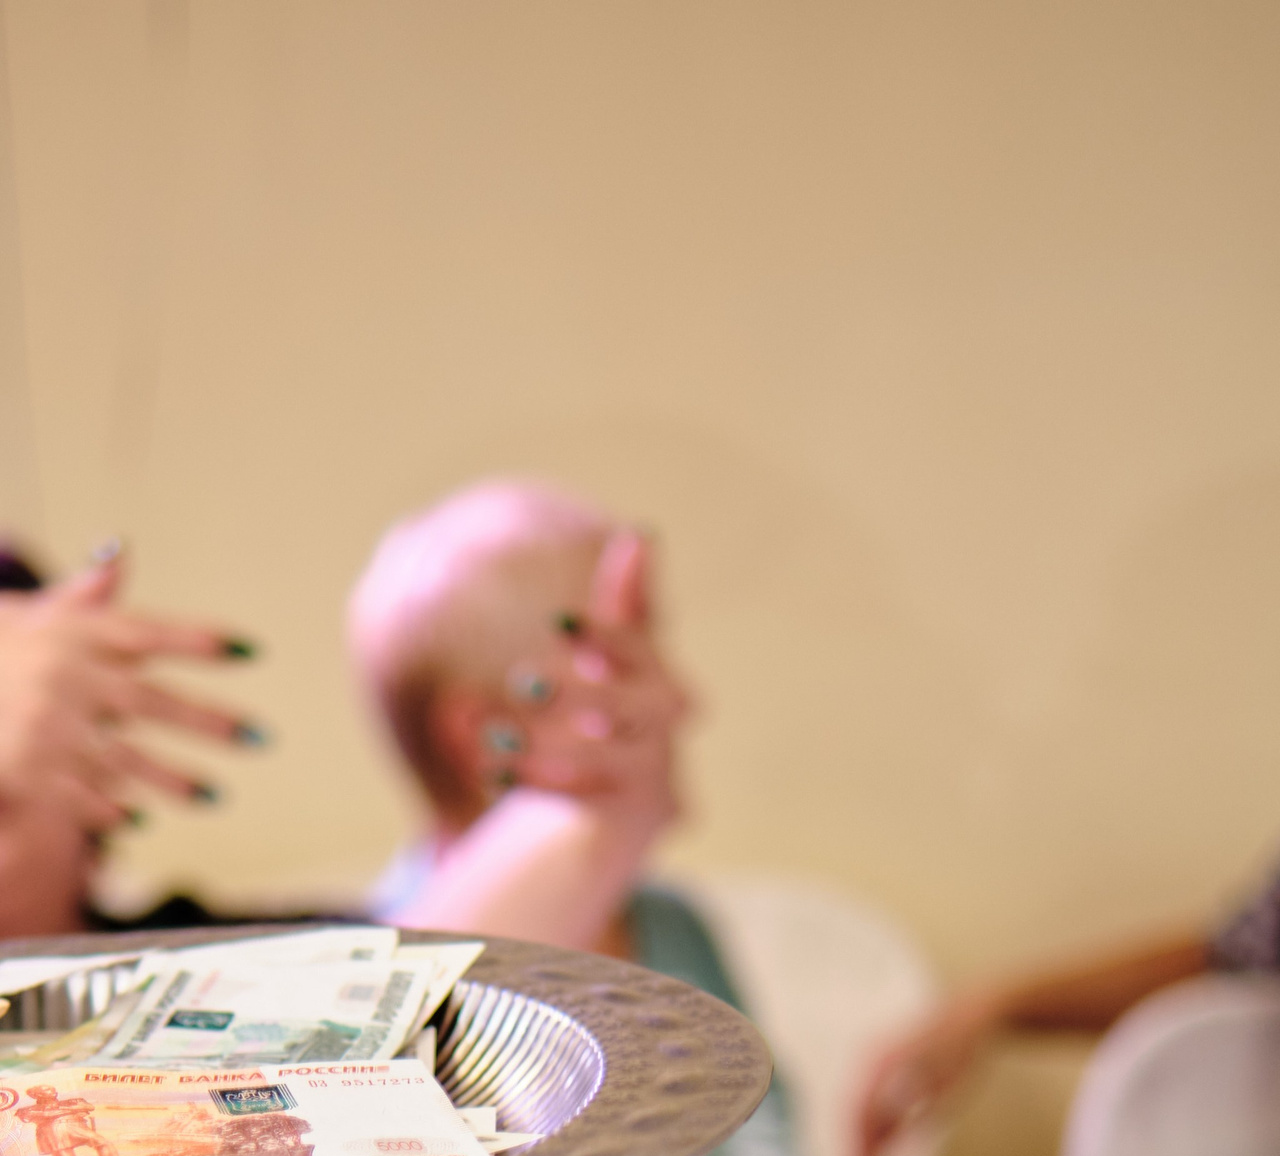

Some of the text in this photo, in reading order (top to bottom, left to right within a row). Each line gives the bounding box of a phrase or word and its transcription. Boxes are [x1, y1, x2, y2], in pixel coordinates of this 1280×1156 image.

[84, 1073, 166, 1085] БИЛЕТ
[179, 1072, 263, 1084] БАНКА
[341, 1077, 425, 1087] 9517273
[376, 1140, 423, 1151] 5000
